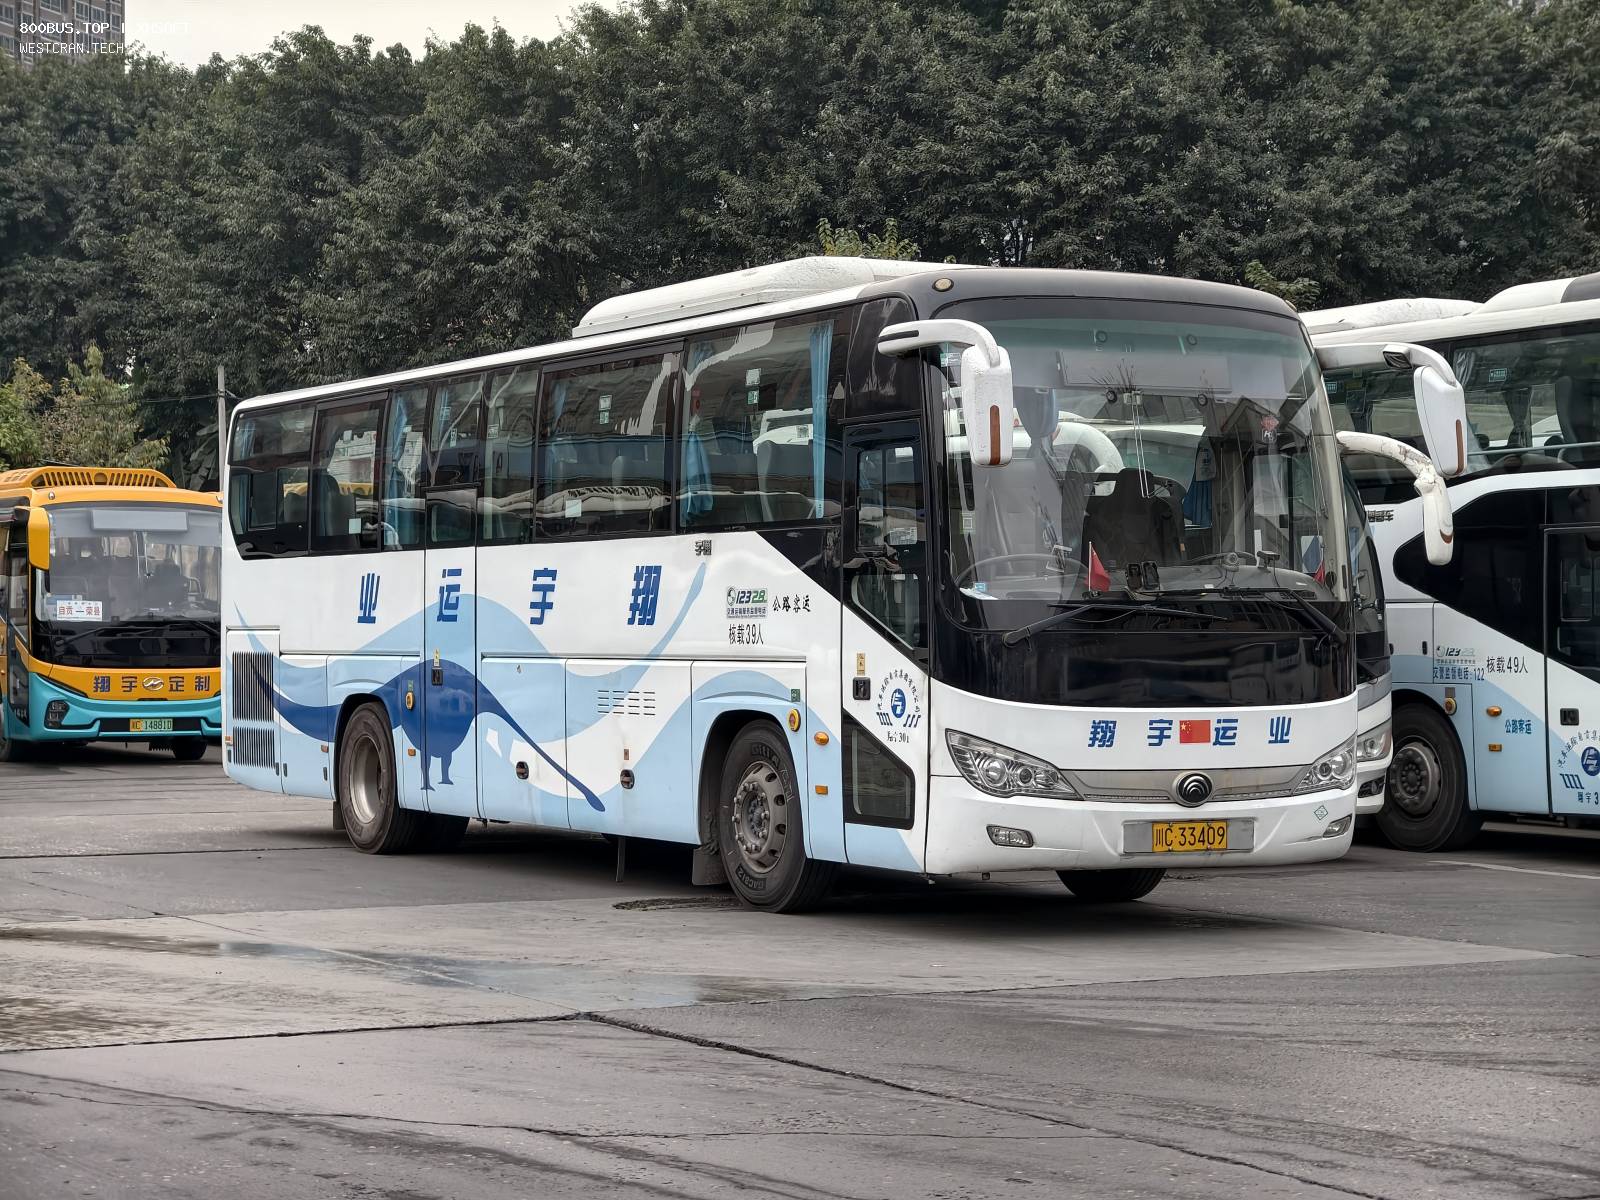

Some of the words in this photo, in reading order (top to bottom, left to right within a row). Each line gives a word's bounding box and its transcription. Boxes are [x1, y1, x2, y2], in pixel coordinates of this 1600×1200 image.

[736, 589, 767, 604] 12328
[772, 593, 811, 613] 公路客运
[728, 623, 764, 645] 核载39人
[1486, 655, 1529, 674] 核载49人
[93, 675, 210, 692] 翔宇定制
[1088, 716, 1292, 748] 翔宇运业
[1504, 719, 1532, 735] 公路客运
